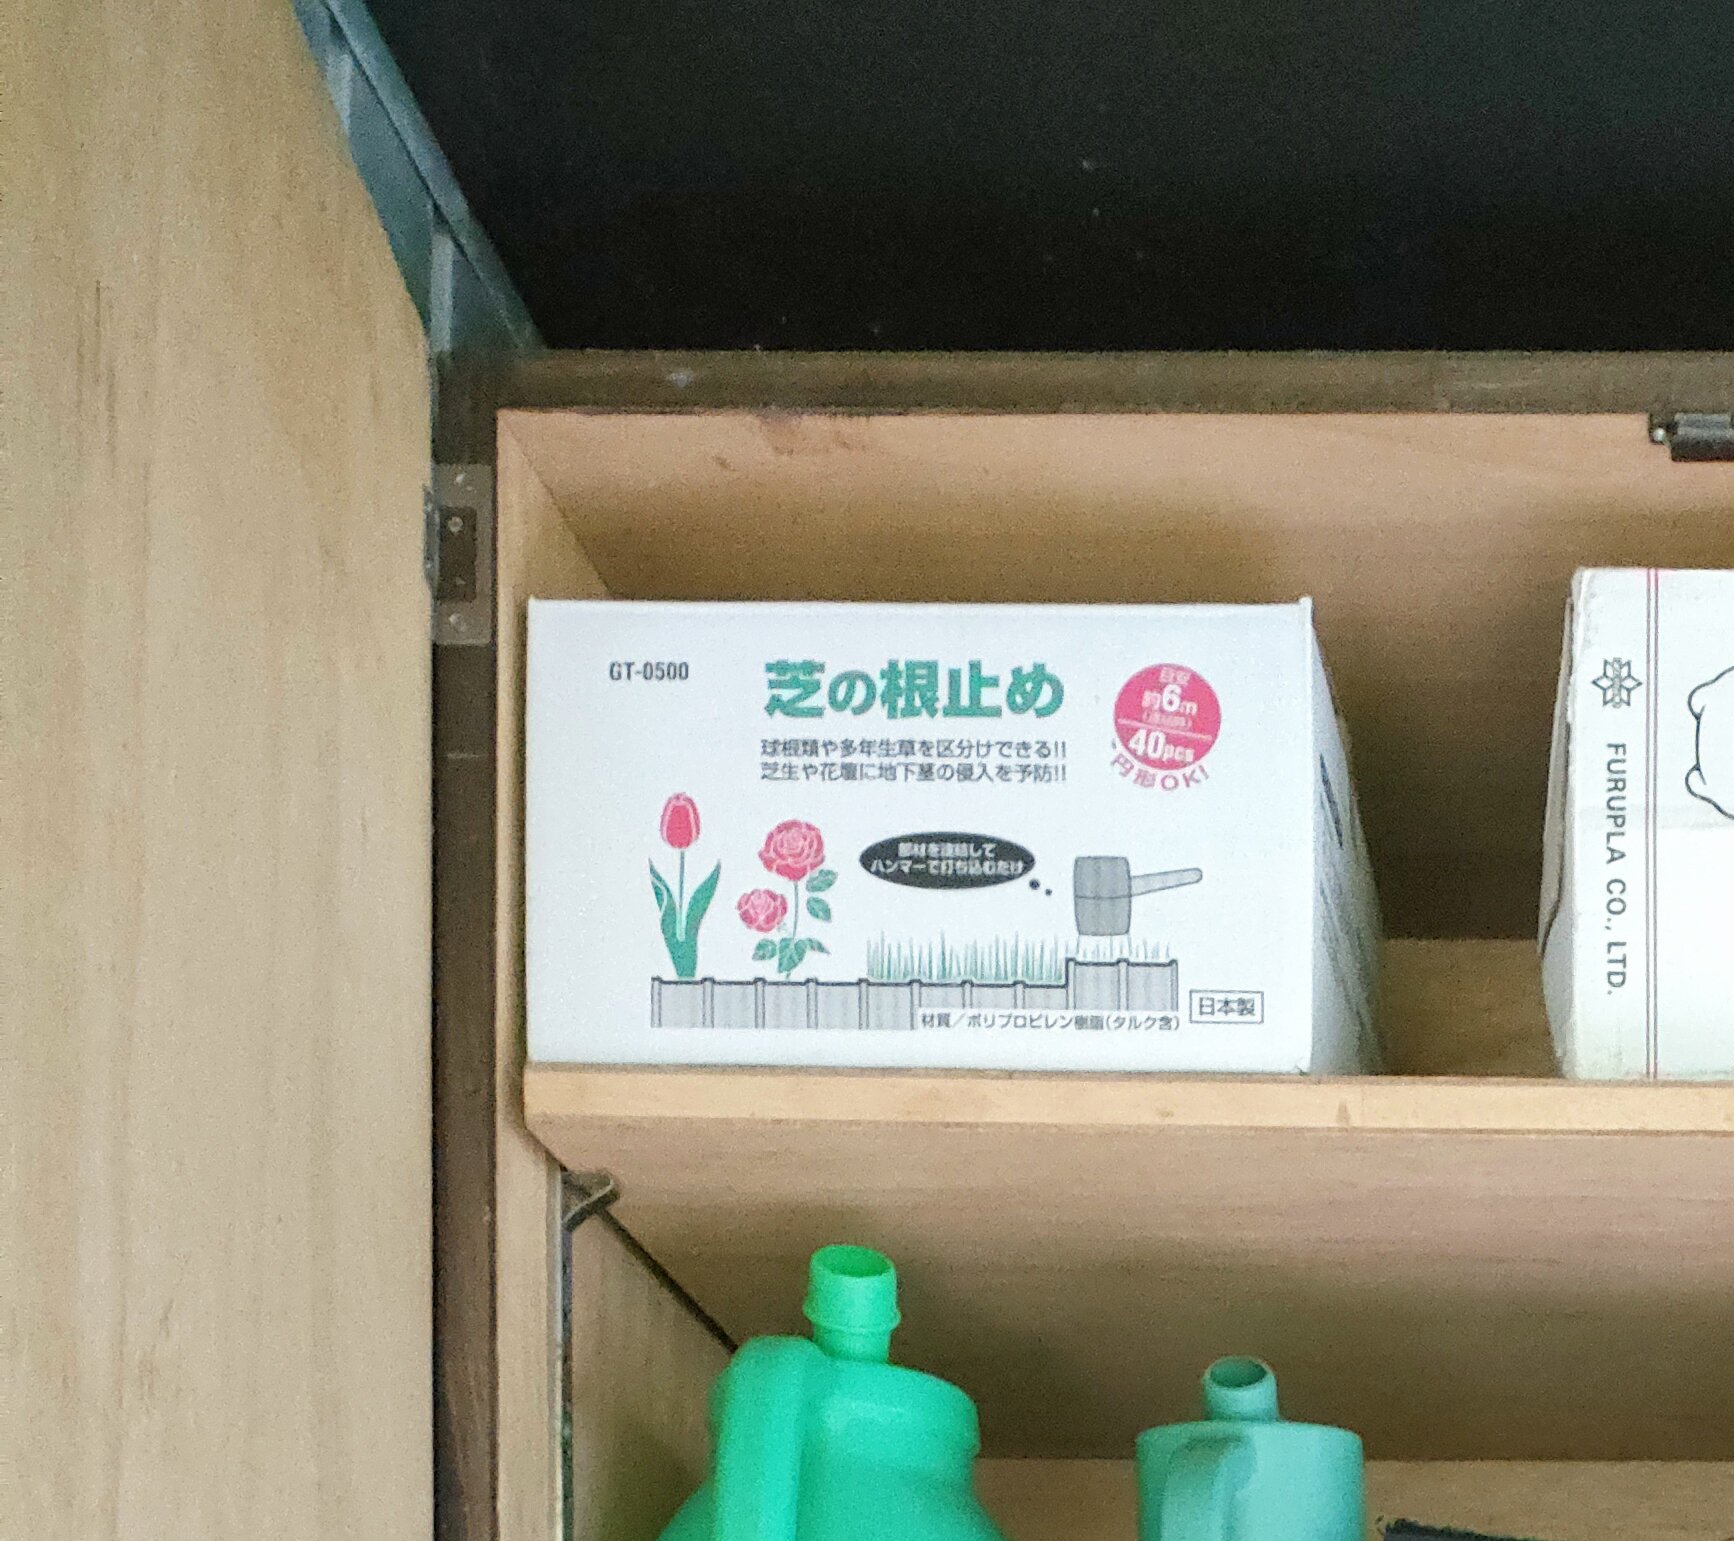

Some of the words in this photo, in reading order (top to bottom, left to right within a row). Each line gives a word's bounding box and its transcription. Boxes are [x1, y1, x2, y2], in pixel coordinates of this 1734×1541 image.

[609, 661, 690, 682] GT-0500
[763, 658, 1066, 719] 芝の根止め
[1128, 729, 1196, 763] 40pcs
[1605, 742, 1628, 865] FURUPLA
[1606, 940, 1628, 995] LTD.
[1198, 996, 1257, 1017] 日本製
